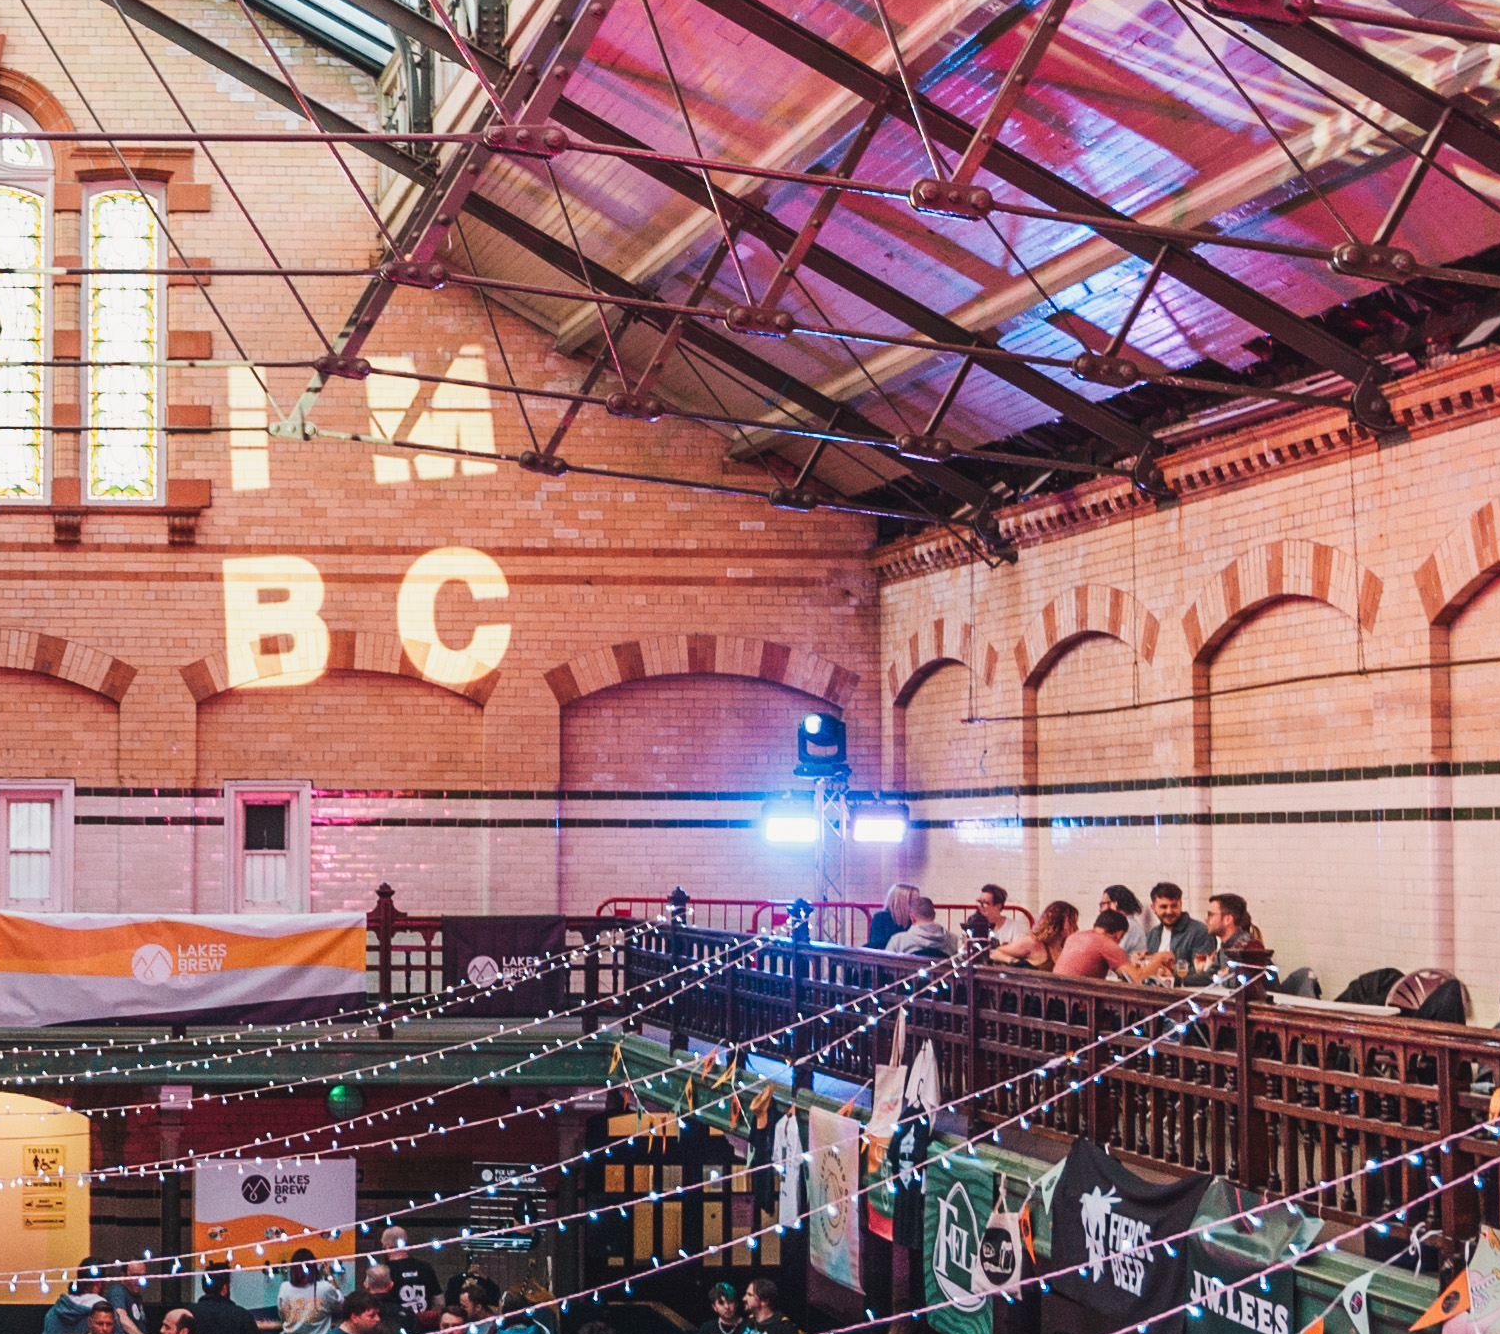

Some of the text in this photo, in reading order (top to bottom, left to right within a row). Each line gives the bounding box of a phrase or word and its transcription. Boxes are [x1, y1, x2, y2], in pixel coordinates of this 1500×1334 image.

[177, 943, 228, 959] LAKES
[177, 957, 224, 971] BREW
[273, 1174, 311, 1187] LAKES
[273, 1184, 308, 1196] BREW
